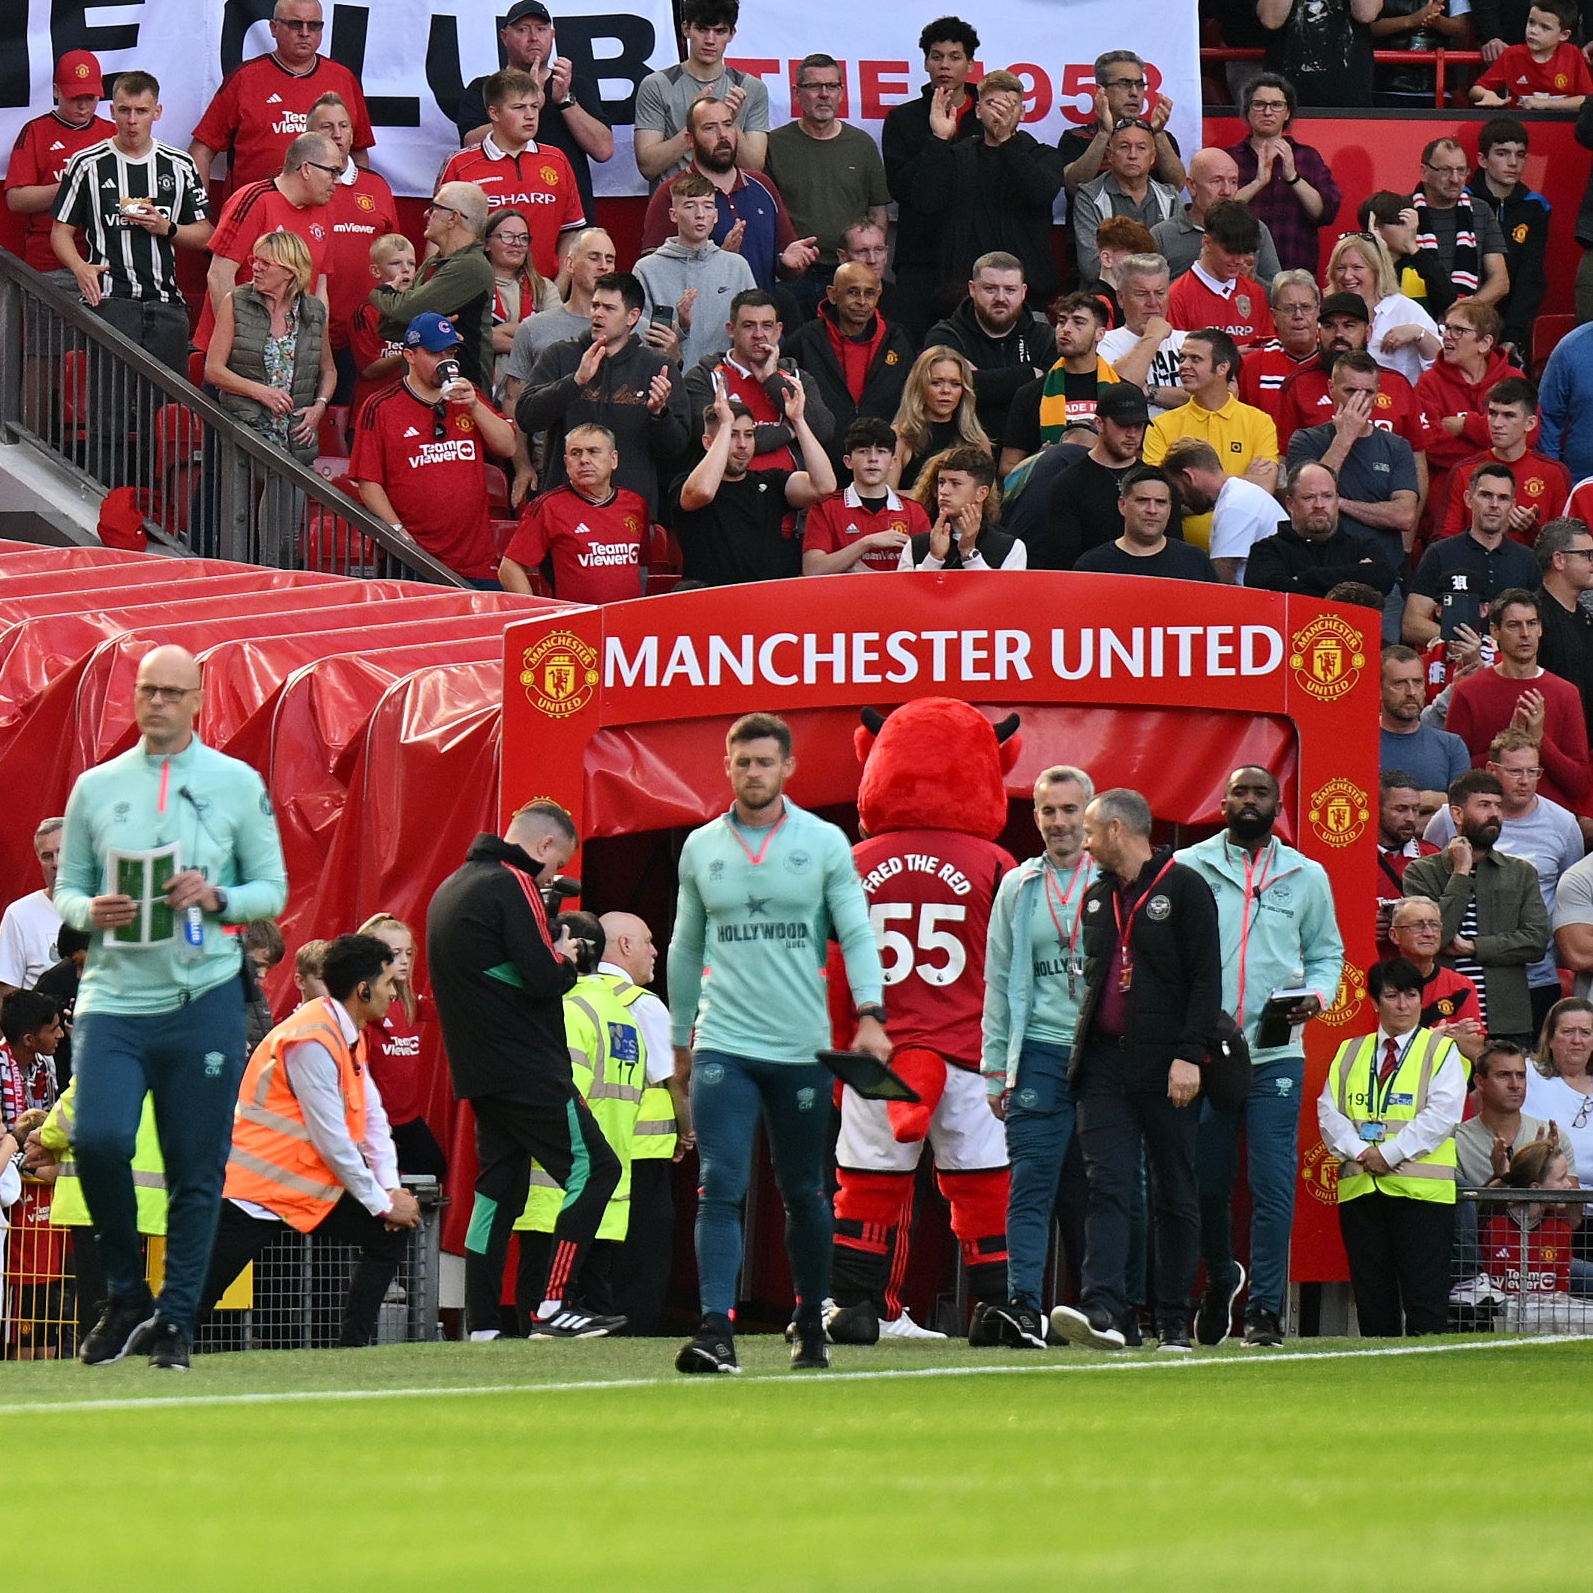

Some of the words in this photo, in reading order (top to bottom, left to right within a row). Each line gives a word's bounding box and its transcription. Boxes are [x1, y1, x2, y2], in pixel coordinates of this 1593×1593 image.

[273, 121, 308, 134] View
[488, 192, 557, 208] SHARP
[438, 320, 451, 334] C
[419, 440, 457, 456] Team
[408, 452, 457, 469] Viewer
[592, 542, 629, 557] Team
[578, 554, 629, 569] Viewer
[1297, 616, 1361, 650] MANCHESTER
[529, 636, 592, 666] MANCHESTER
[604, 629, 1033, 688] MANCHESTER
[1051, 624, 1285, 680] UNITED
[1306, 678, 1350, 697] UNITED
[536, 696, 583, 713] UNITED
[1314, 781, 1365, 806] MANCHESTER
[1321, 829, 1357, 843] UNITED
[862, 856, 904, 895] FRED
[904, 853, 939, 875] THE
[938, 863, 973, 896] RED
[717, 923, 808, 943] HOLLYWOOD
[870, 902, 967, 986] 55
[617, 1059, 636, 1085] 17
